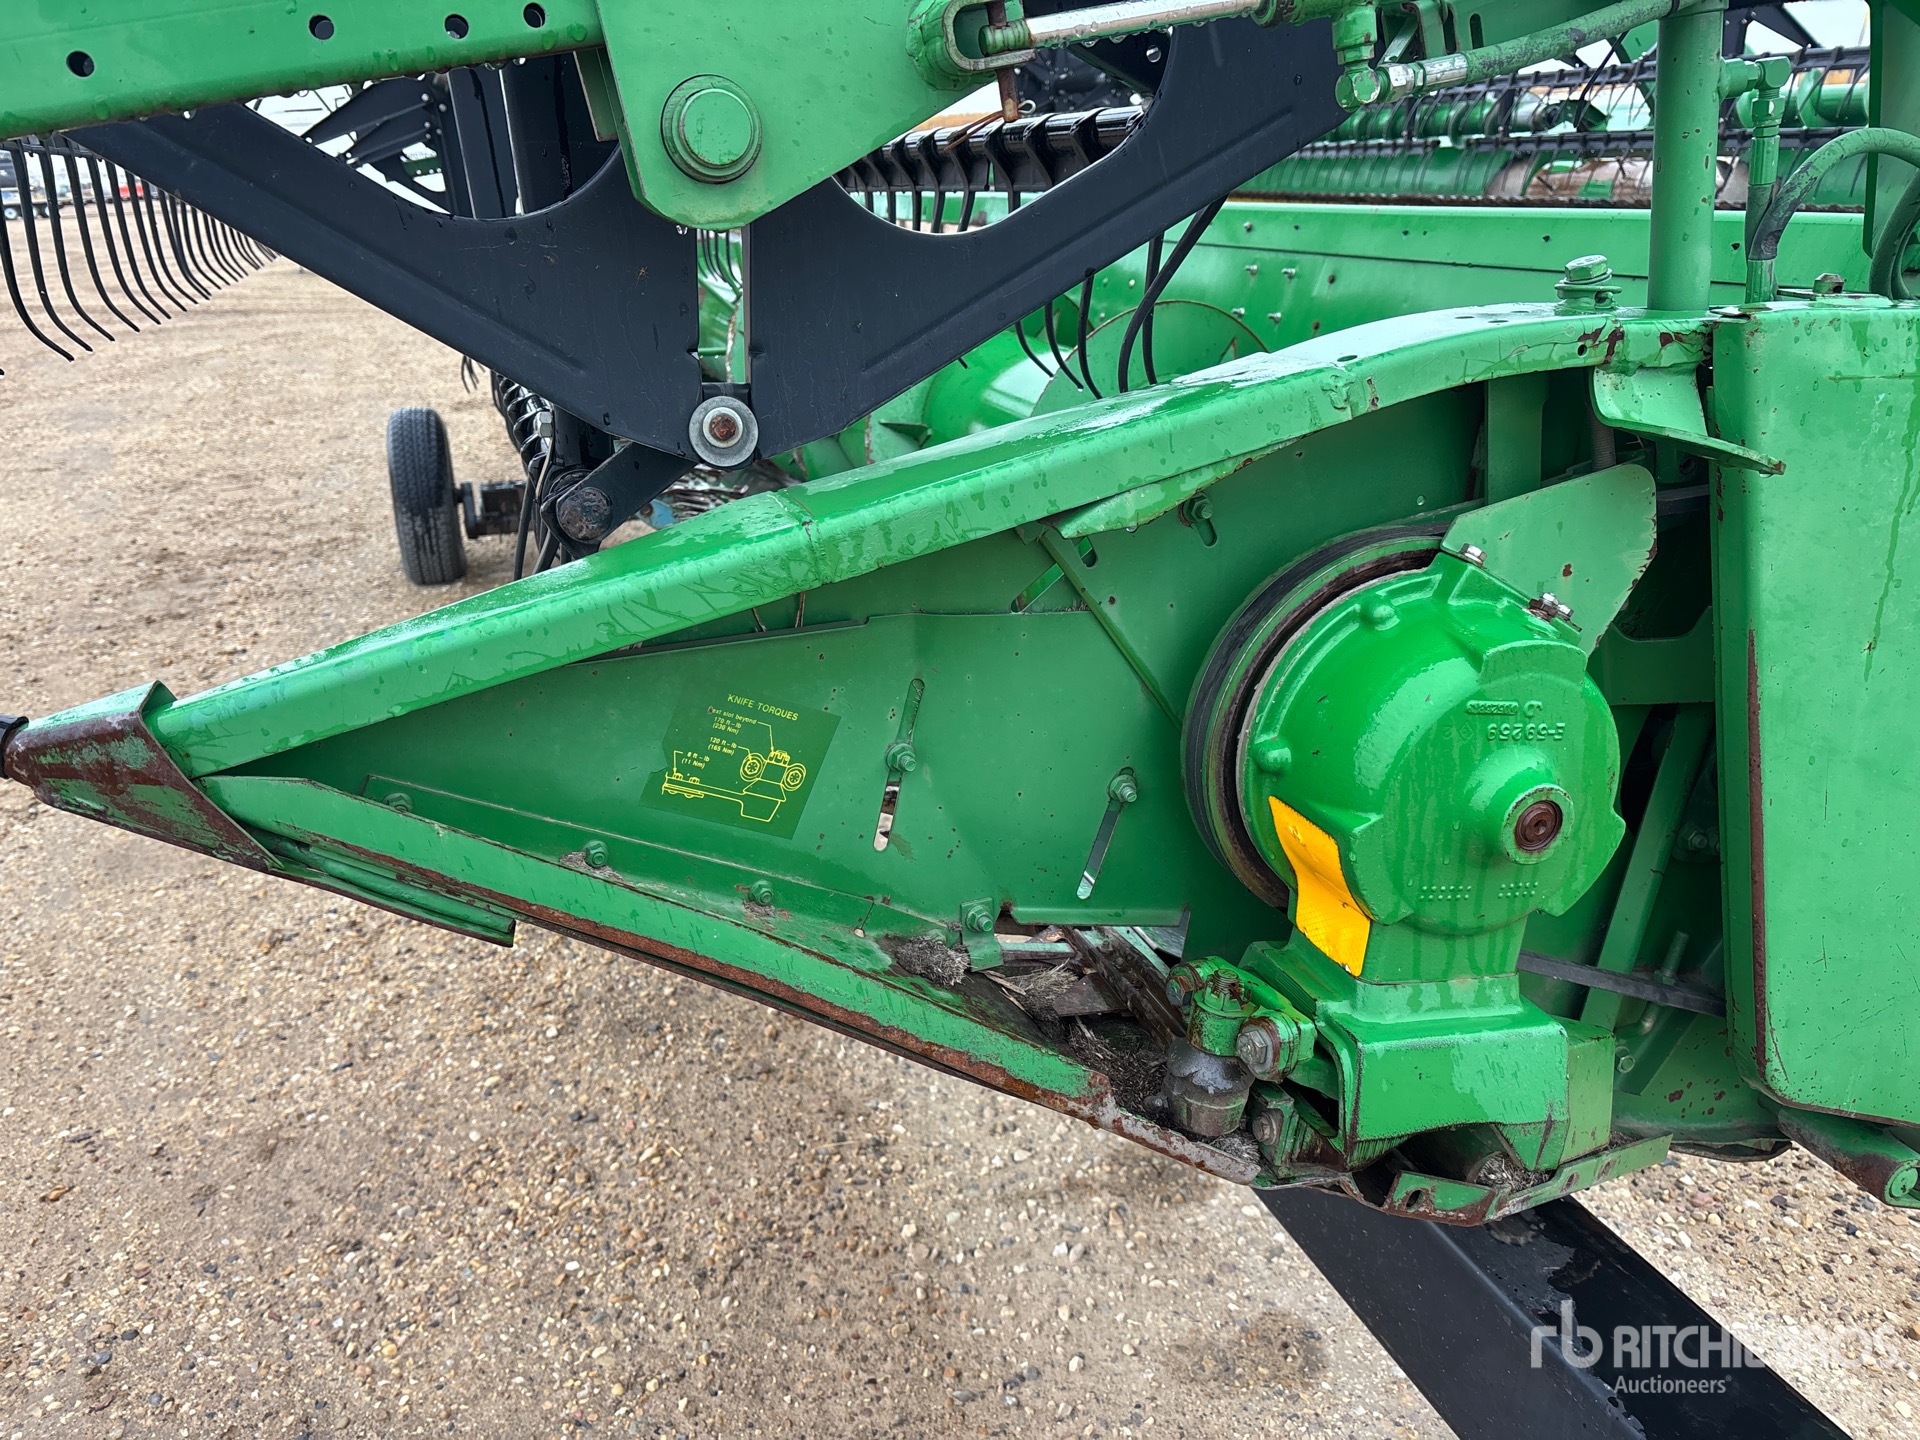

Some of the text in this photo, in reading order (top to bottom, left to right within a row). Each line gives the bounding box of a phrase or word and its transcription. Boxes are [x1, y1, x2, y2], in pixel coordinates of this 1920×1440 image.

[728, 694, 798, 721] KNIFE TORQUES
[736, 714, 757, 724] beyond
[726, 726, 739, 735] Nm)
[722, 747, 734, 756] Nm)
[693, 760, 705, 769] Nm)
